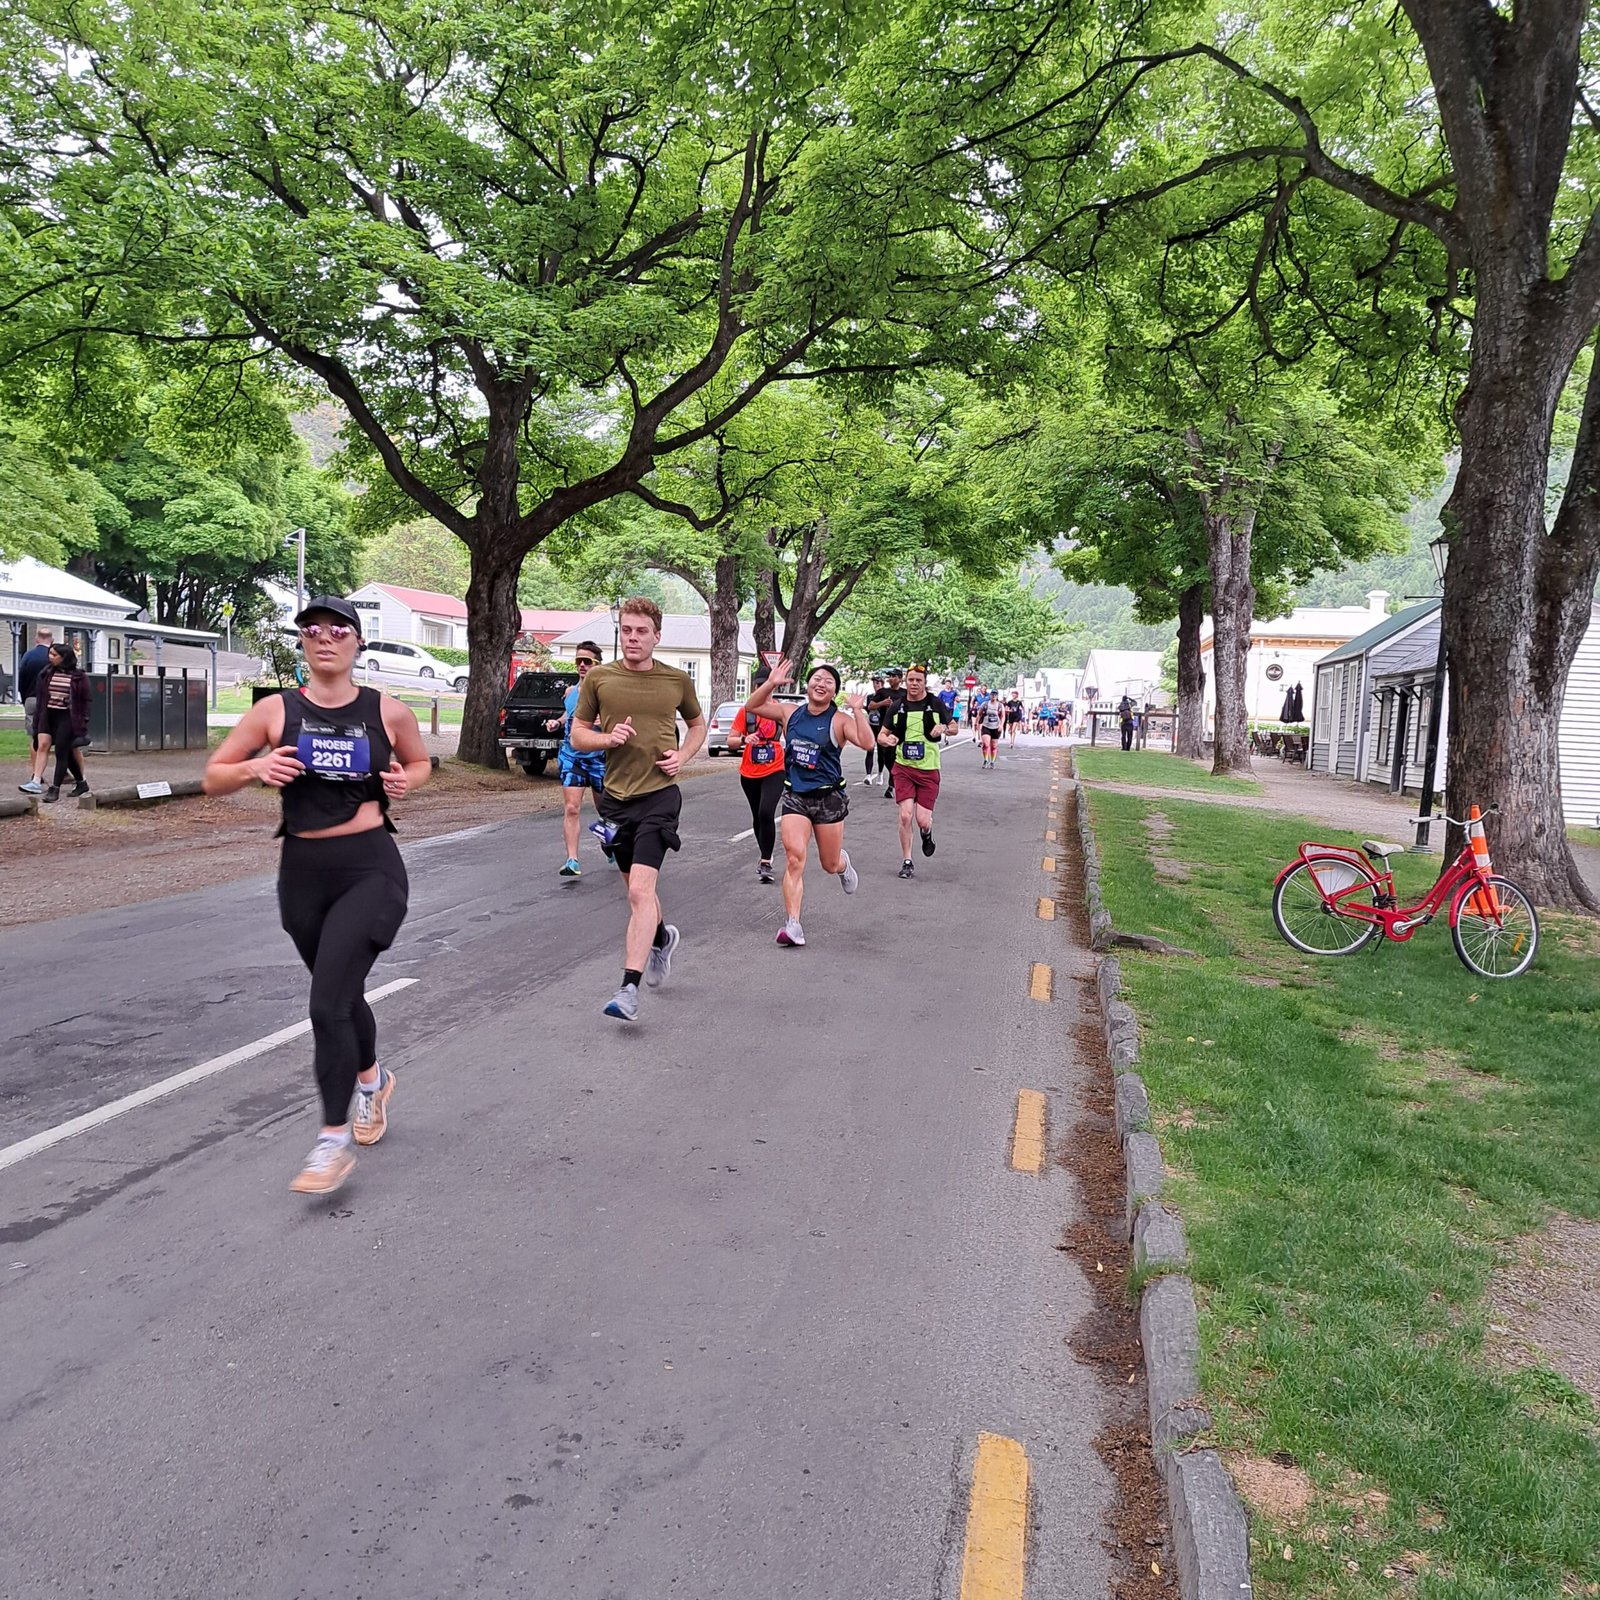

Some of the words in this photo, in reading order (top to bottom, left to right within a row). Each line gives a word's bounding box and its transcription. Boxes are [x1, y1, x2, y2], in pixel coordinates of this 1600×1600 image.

[351, 601, 380, 609] POLICE
[312, 738, 354, 751] PHOEBE
[311, 751, 351, 768] 2261
